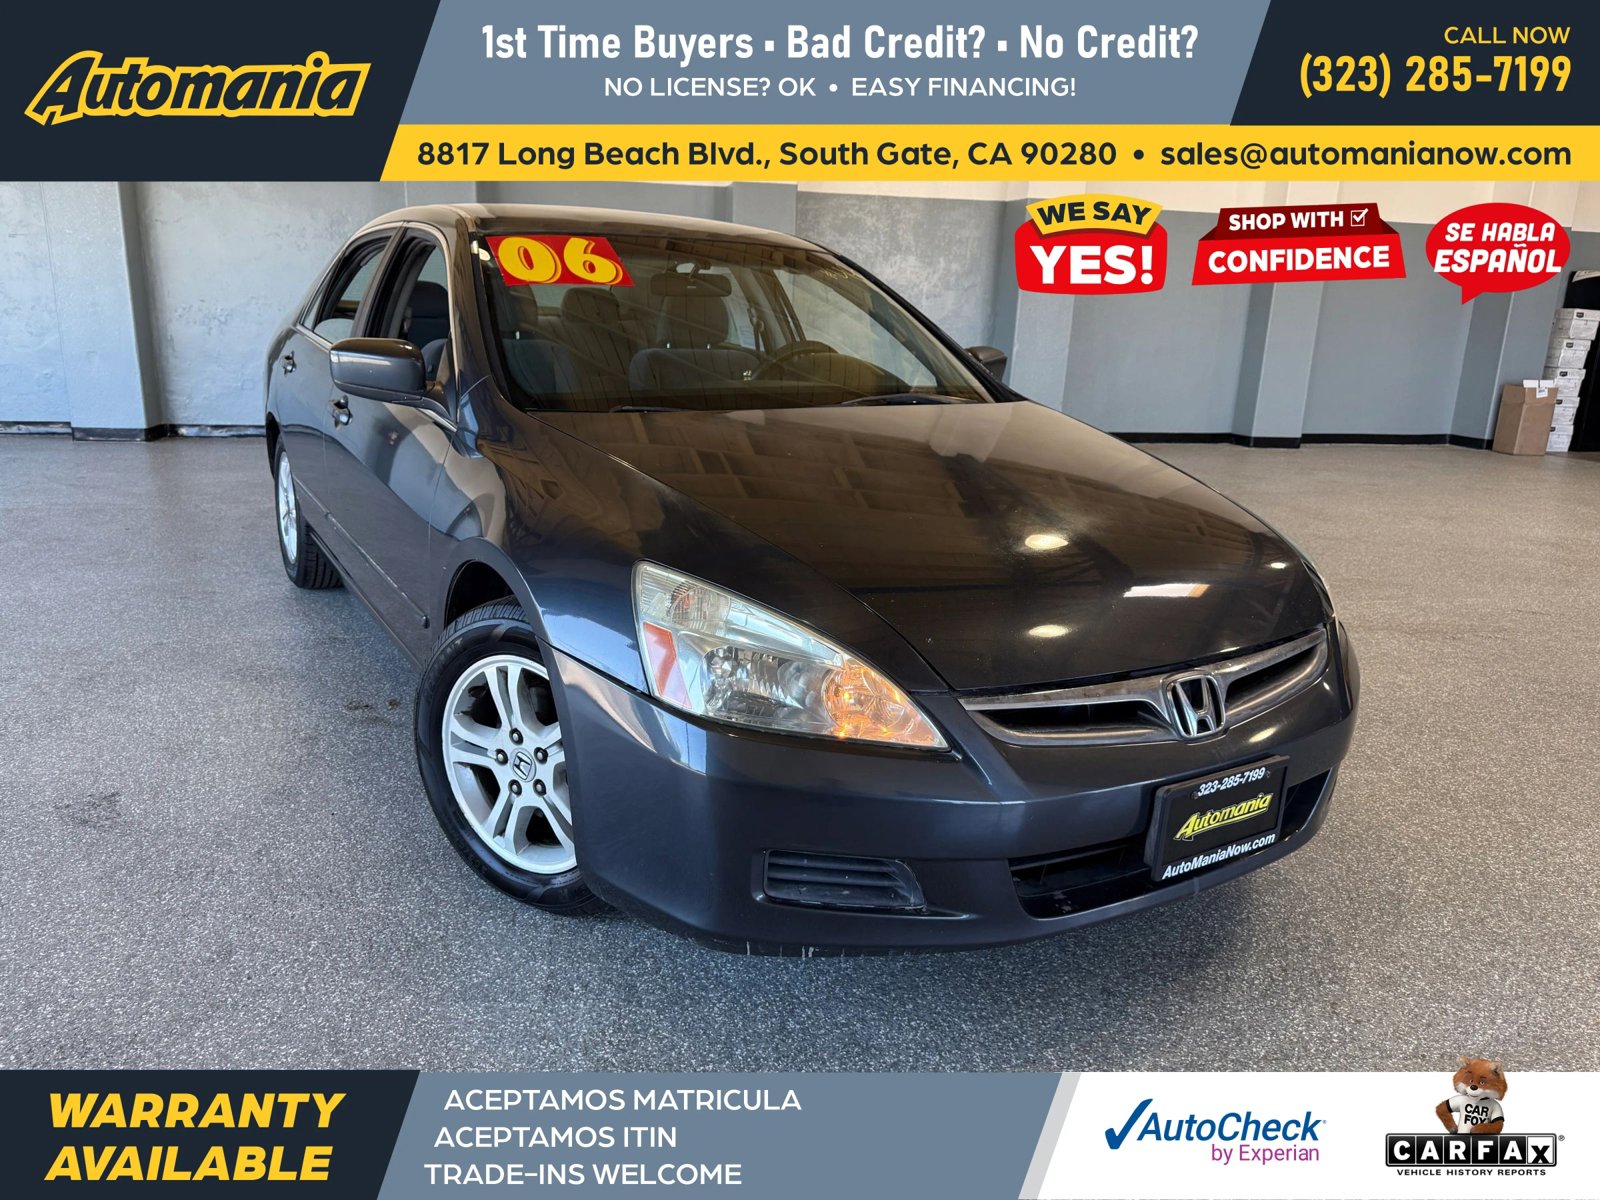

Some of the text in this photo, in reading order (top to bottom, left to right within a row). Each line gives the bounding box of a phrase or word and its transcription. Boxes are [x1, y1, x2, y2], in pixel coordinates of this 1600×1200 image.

[498, 236, 622, 285] 06
[1197, 767, 1266, 797] 323-285-7199
[1173, 792, 1274, 841] Automania
[1162, 833, 1276, 880] AutoManiaNow.com
